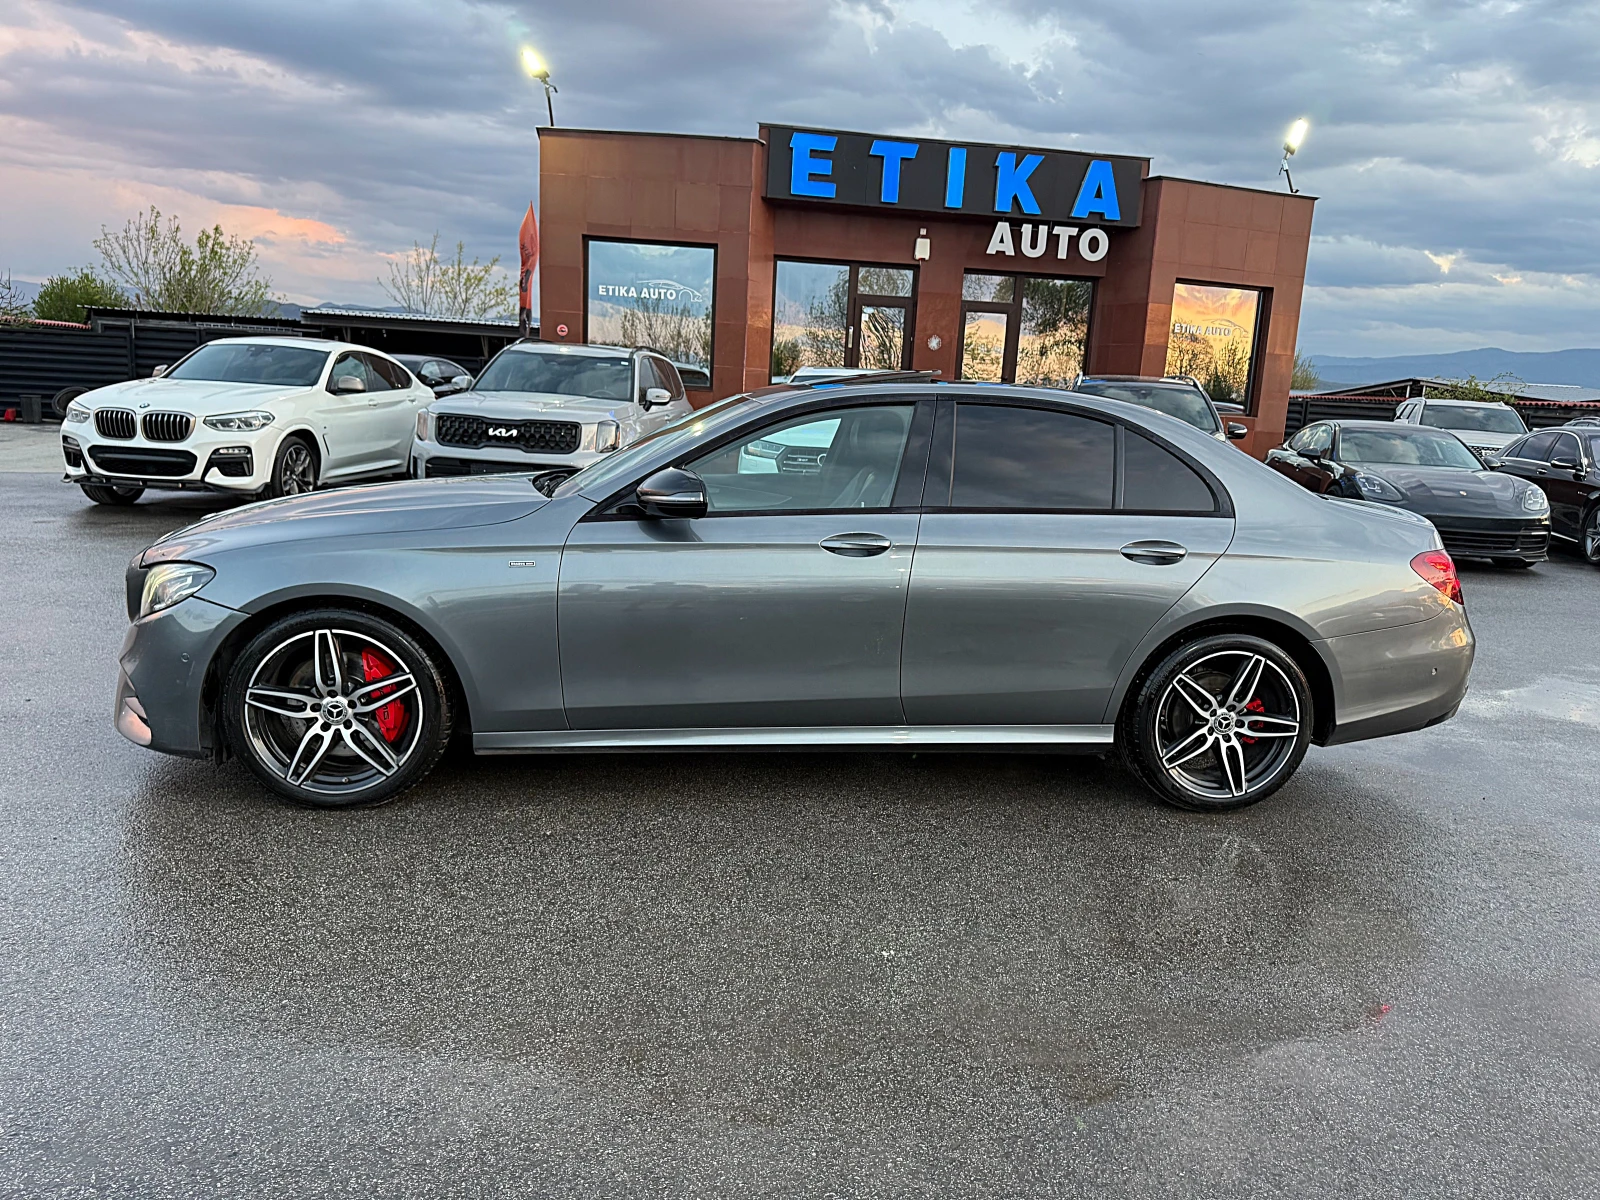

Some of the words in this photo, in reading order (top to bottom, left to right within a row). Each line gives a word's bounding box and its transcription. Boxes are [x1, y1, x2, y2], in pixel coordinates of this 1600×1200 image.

[789, 131, 1121, 221] ETIKA
[986, 221, 1109, 262] AUTO
[598, 284, 637, 298] ETIKA
[640, 287, 677, 301] AUTO
[1174, 323, 1203, 335] ETIKA
[1204, 325, 1232, 337] AUTO
